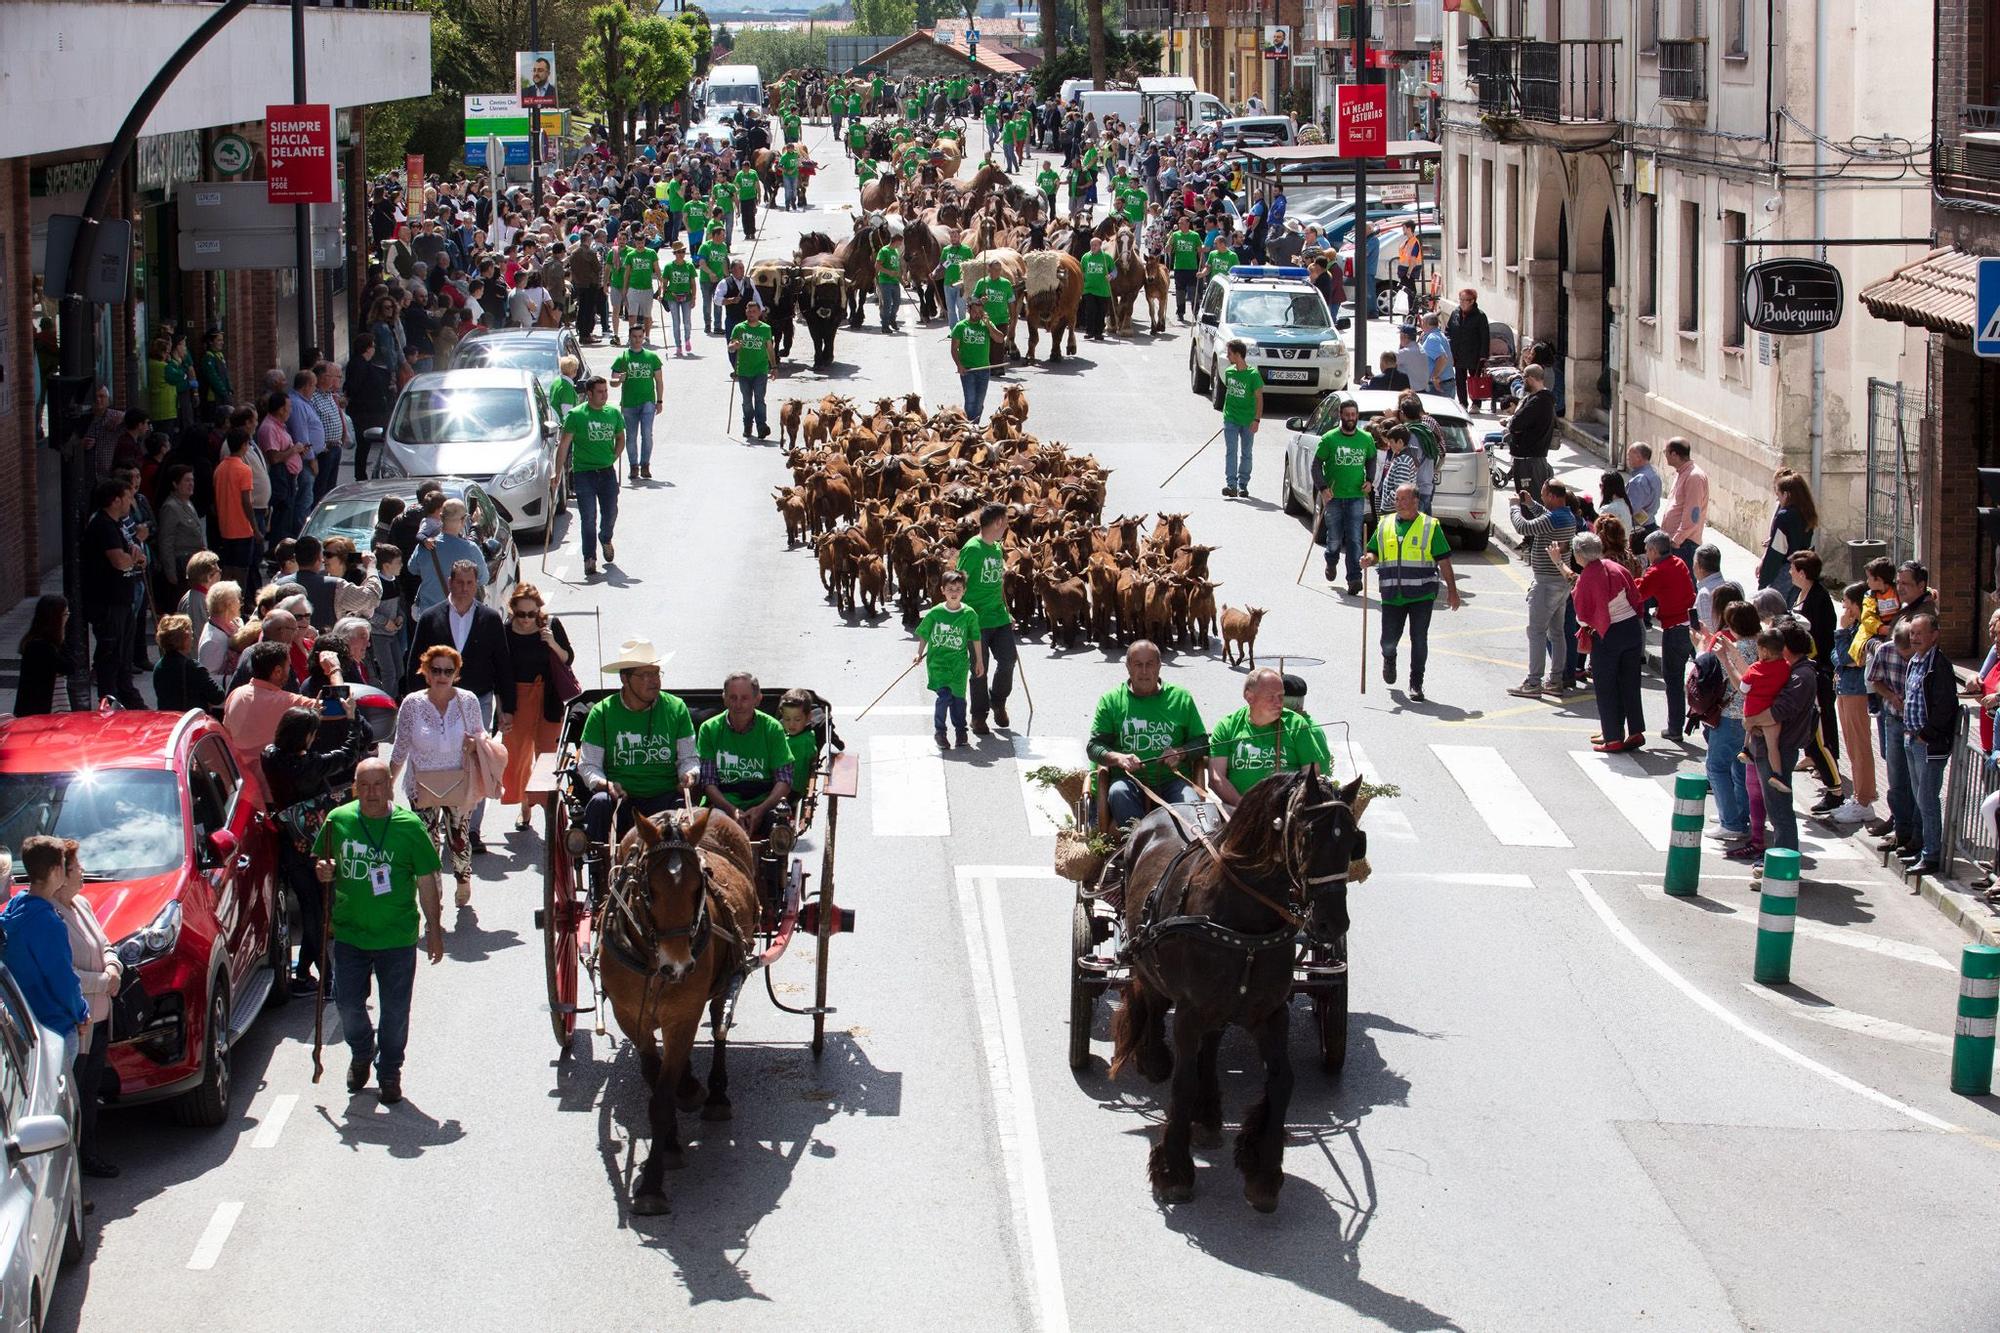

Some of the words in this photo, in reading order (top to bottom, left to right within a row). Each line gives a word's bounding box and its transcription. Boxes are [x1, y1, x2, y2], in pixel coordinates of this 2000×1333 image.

[1342, 106, 1351, 116] LA
[1352, 101, 1374, 114] MEJOR
[1352, 108, 1383, 124] ASTURIAS
[270, 121, 321, 133] SIEMPRE
[271, 134, 310, 145] HACIA
[271, 146, 325, 157] DELANTE
[1770, 275, 1796, 297] La
[1761, 301, 1834, 328] Bodeguina
[1149, 720, 1175, 733] SAN
[642, 733, 670, 747] SAN
[1119, 731, 1173, 751] ISIDRO
[613, 745, 672, 767] ISIDRO
[738, 758, 765, 770] SAN
[366, 847, 394, 862] SAN
